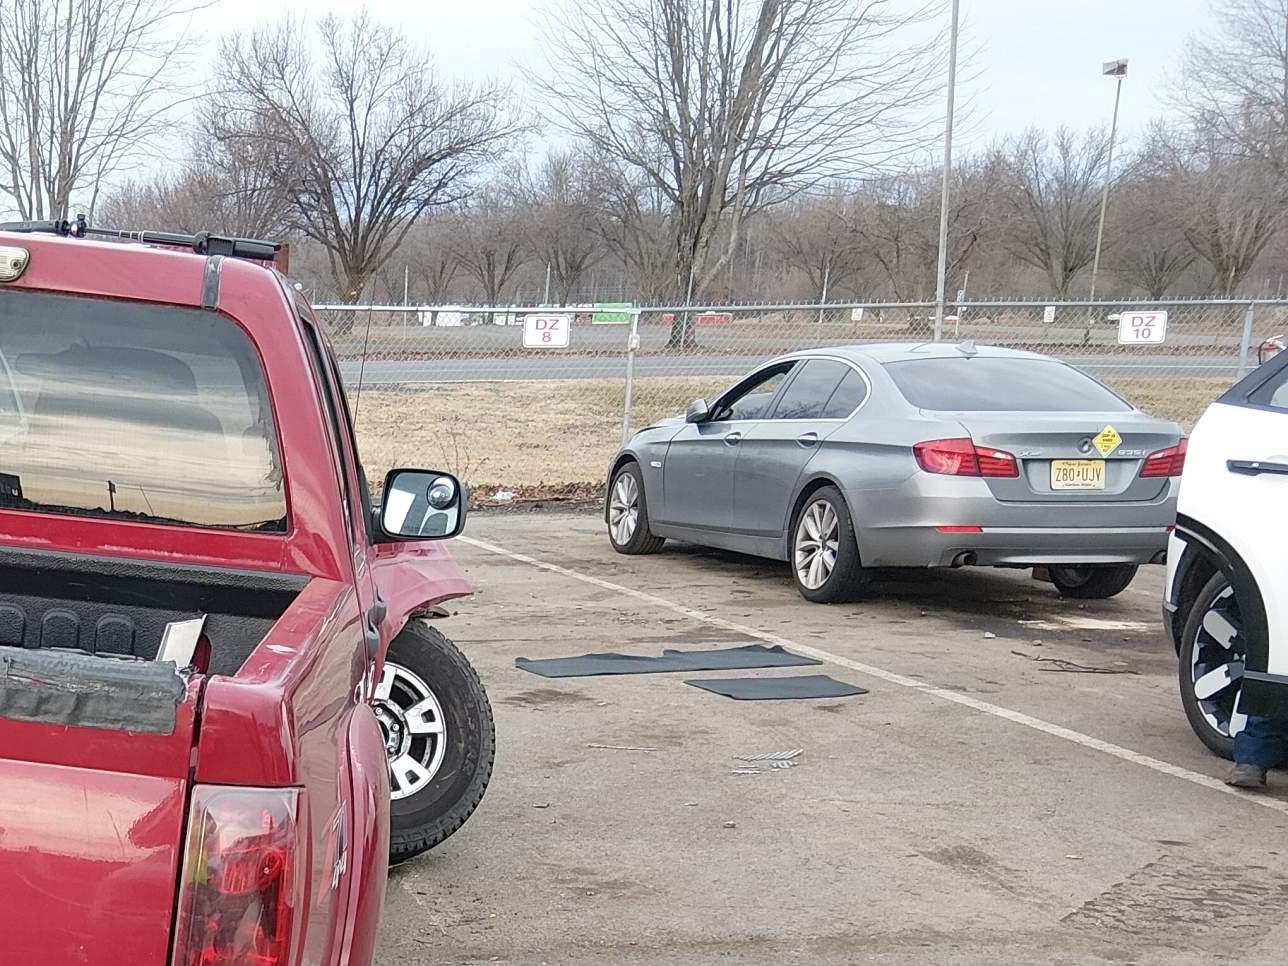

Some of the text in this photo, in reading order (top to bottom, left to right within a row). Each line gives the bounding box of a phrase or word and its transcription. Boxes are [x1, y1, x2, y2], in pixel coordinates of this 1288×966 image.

[535, 318, 560, 331] DZ
[1131, 315, 1157, 328] DZ
[541, 331, 551, 343] 8
[1133, 327, 1151, 339] 10
